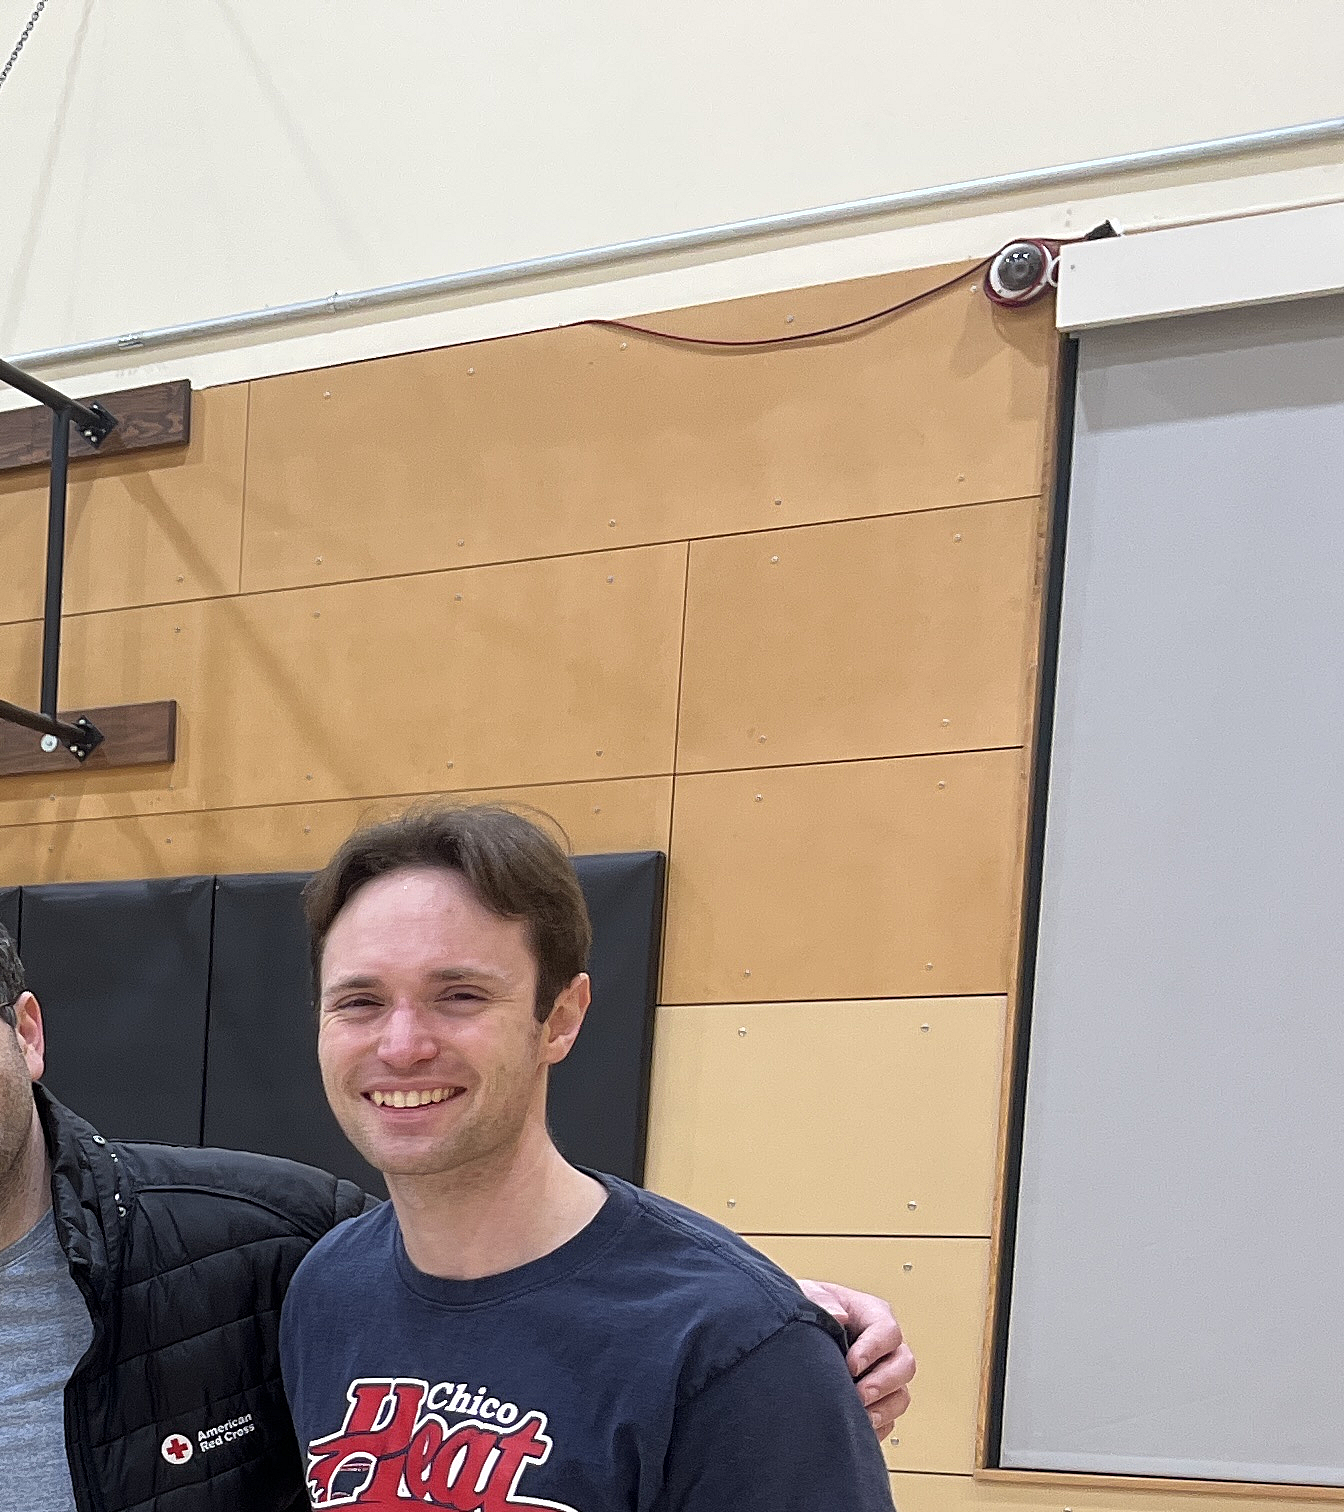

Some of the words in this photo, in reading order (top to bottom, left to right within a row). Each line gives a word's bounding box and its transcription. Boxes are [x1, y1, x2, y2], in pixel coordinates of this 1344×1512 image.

[426, 1382, 519, 1425] Chico
[197, 1413, 253, 1442] American
[199, 1435, 224, 1452] Red
[223, 1423, 255, 1442] Cross
